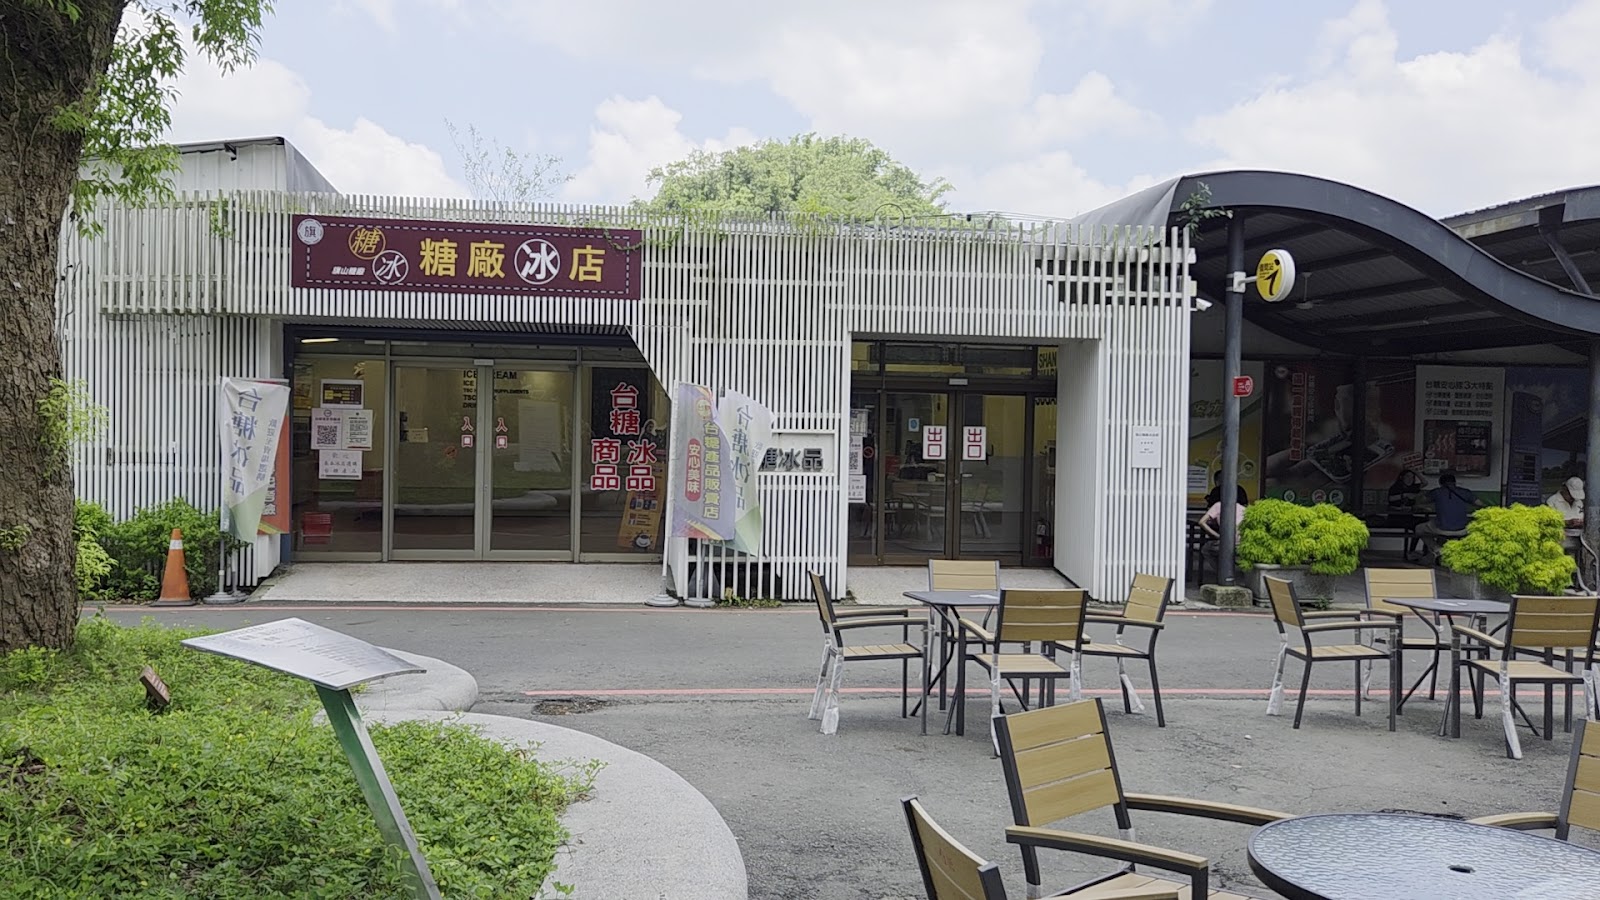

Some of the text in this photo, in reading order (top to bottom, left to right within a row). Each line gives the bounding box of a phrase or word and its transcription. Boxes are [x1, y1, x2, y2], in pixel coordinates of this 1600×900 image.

[304, 226, 317, 238] 旗
[352, 228, 380, 254] 糖
[376, 255, 405, 280] 冰
[610, 382, 640, 435] 台糖
[928, 427, 942, 457] 出口
[968, 428, 982, 458] 出口
[591, 437, 621, 490] 商品
[626, 439, 657, 491] 冰品
[687, 444, 700, 493] 安心美味
